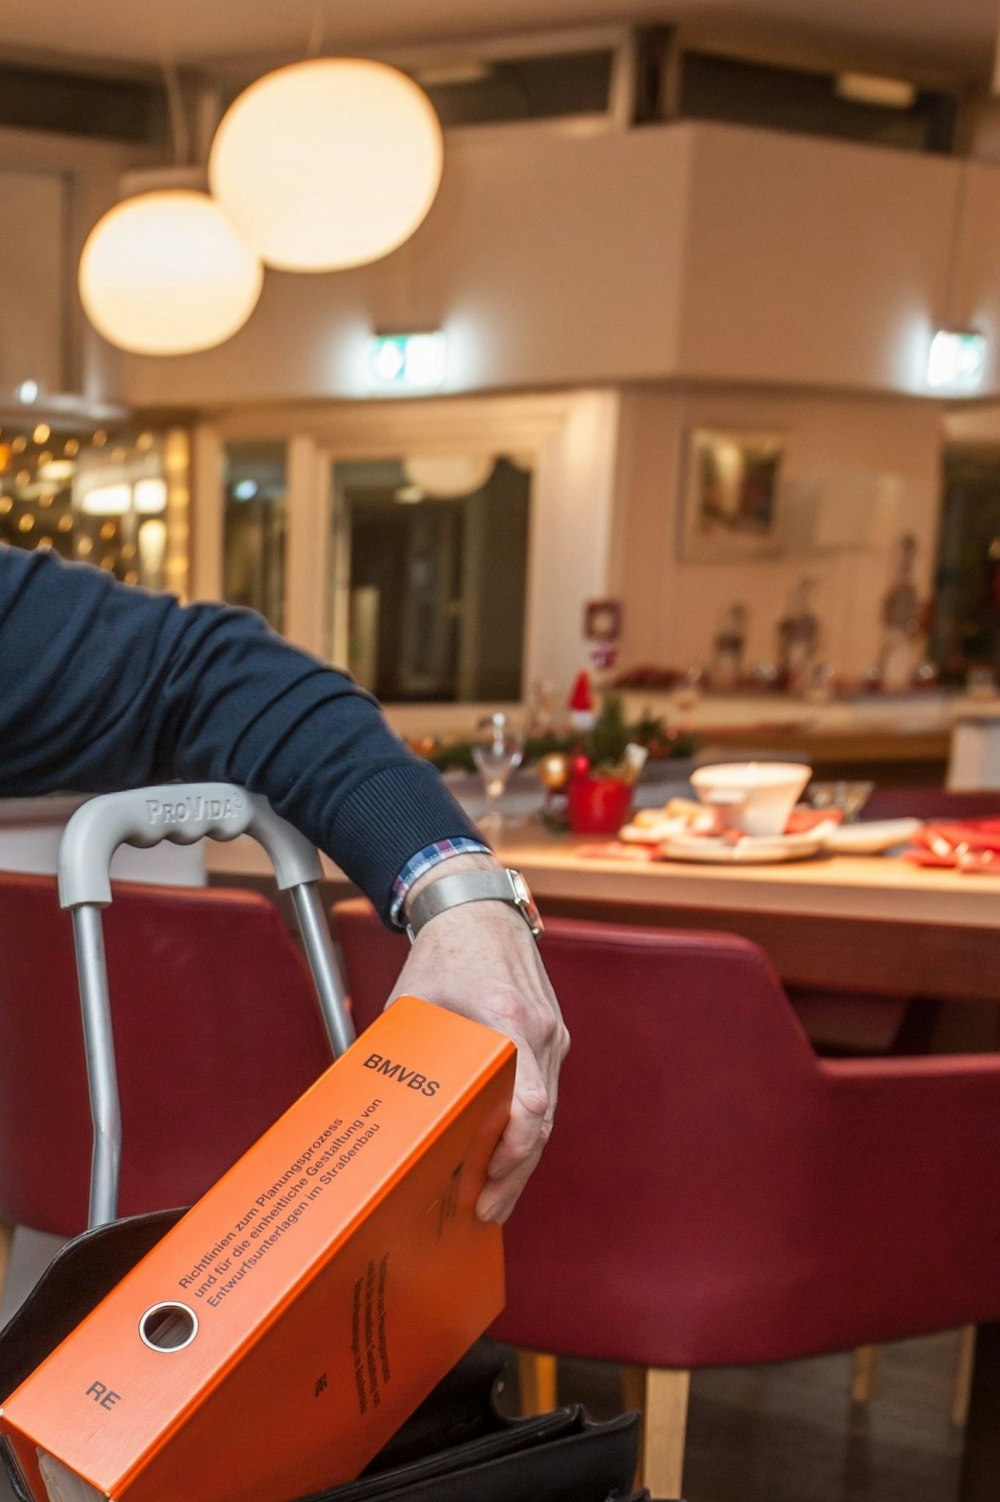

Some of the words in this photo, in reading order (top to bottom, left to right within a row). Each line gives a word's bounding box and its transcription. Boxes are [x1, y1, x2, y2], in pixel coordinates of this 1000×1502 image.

[363, 1053, 440, 1097] BMVBS
[178, 1231, 236, 1289] Richtlinien
[234, 1207, 260, 1232] zum
[255, 1118, 344, 1208] Planungsprozess
[194, 1274, 218, 1298] und
[214, 1258, 233, 1275] für
[232, 1240, 251, 1258] die
[250, 1178, 309, 1239] einheitliche
[305, 1119, 365, 1177] Gestaltung
[360, 1098, 383, 1118] von
[206, 1201, 309, 1308] Entwurfsunterlagen
[304, 1186, 324, 1201] im
[319, 1123, 381, 1185] Straßenbau
[85, 1380, 122, 1412] RE
